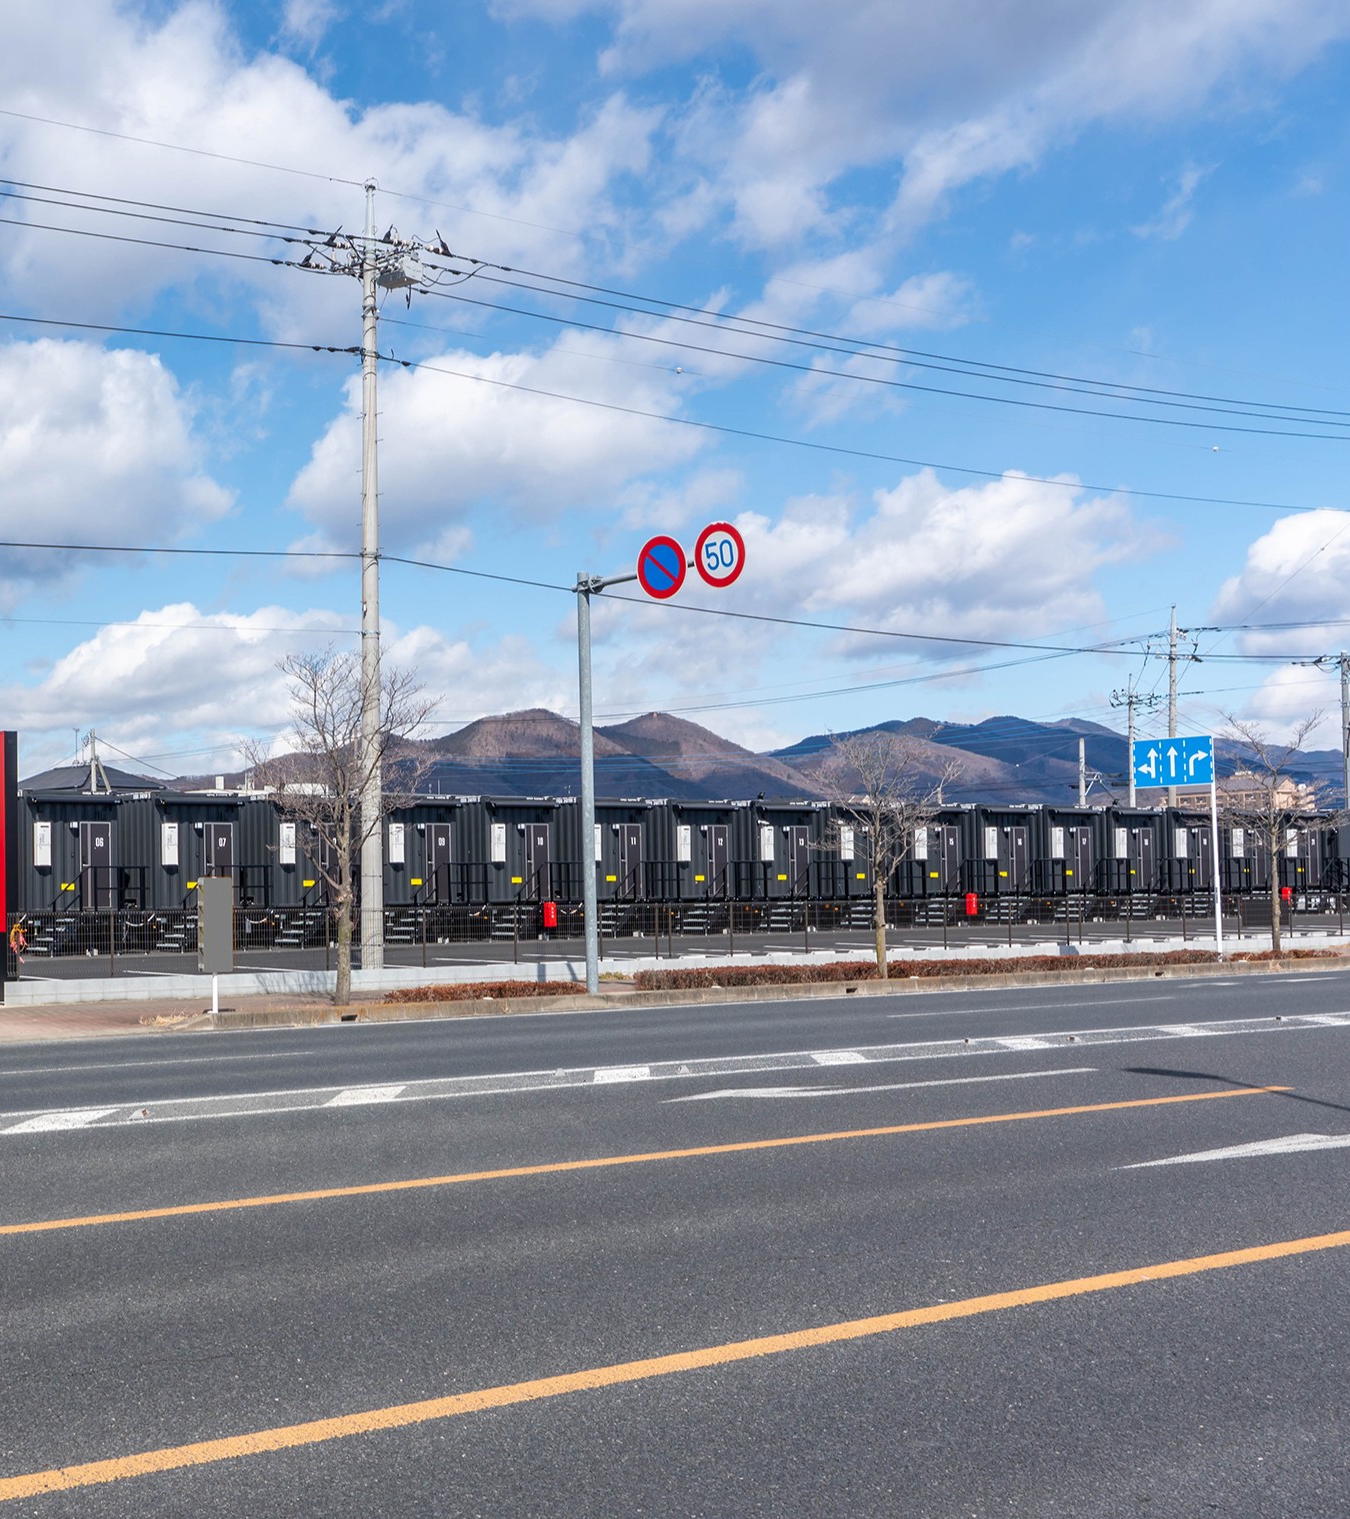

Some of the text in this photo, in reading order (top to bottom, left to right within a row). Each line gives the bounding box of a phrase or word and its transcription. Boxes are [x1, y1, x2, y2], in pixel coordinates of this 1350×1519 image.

[705, 539, 734, 570] 50
[95, 837, 104, 847] 06
[218, 838, 226, 847] 07
[438, 837, 445, 846] 09
[631, 837, 636, 846] 11
